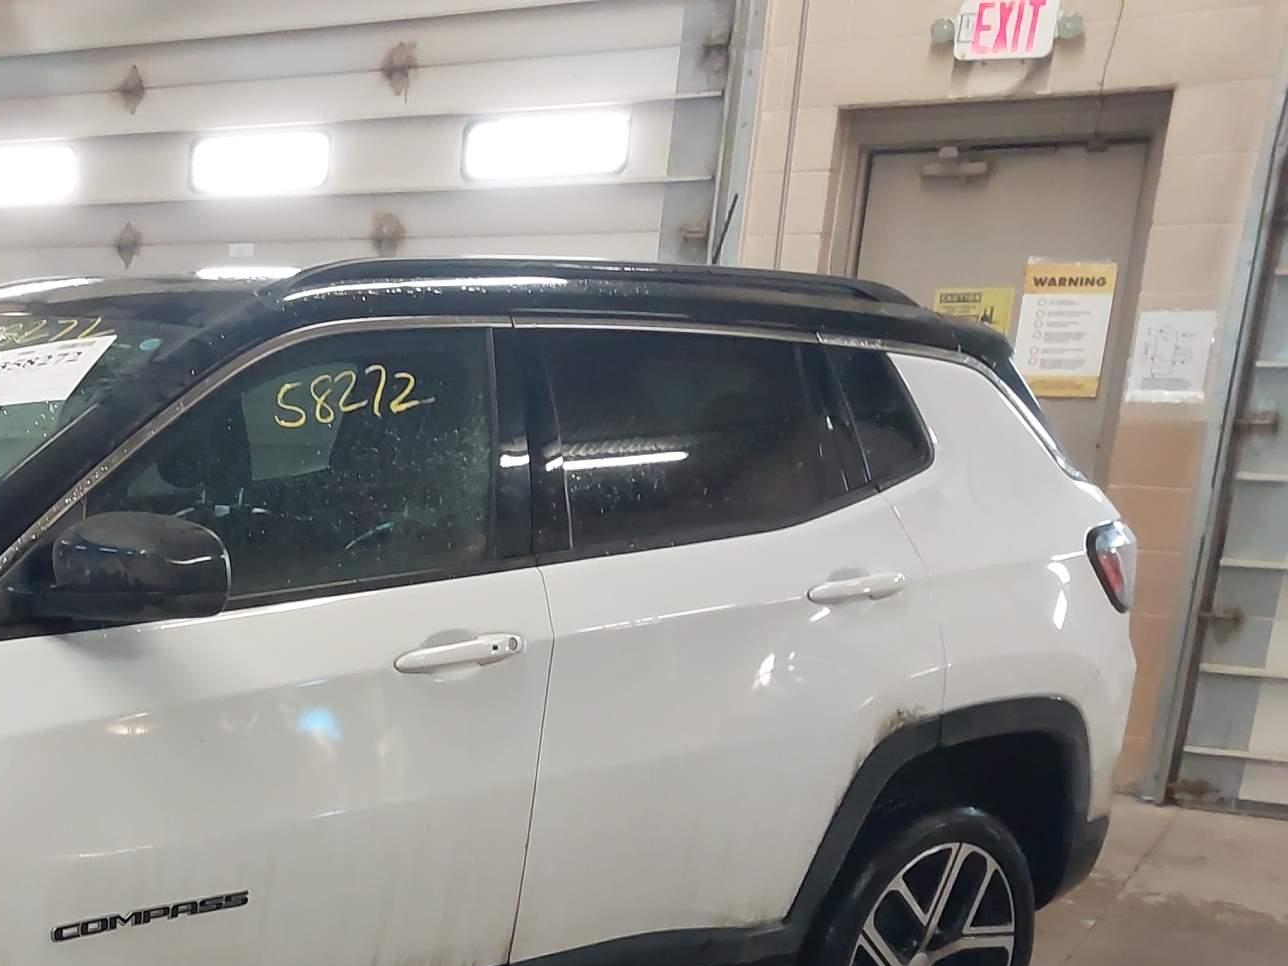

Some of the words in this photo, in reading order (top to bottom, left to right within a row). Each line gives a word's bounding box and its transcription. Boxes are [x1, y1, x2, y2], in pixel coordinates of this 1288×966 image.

[971, 0, 1046, 54] EXIT
[1033, 276, 1107, 287] WARNING
[274, 364, 435, 427] 58272
[50, 889, 250, 943] COMPASS
